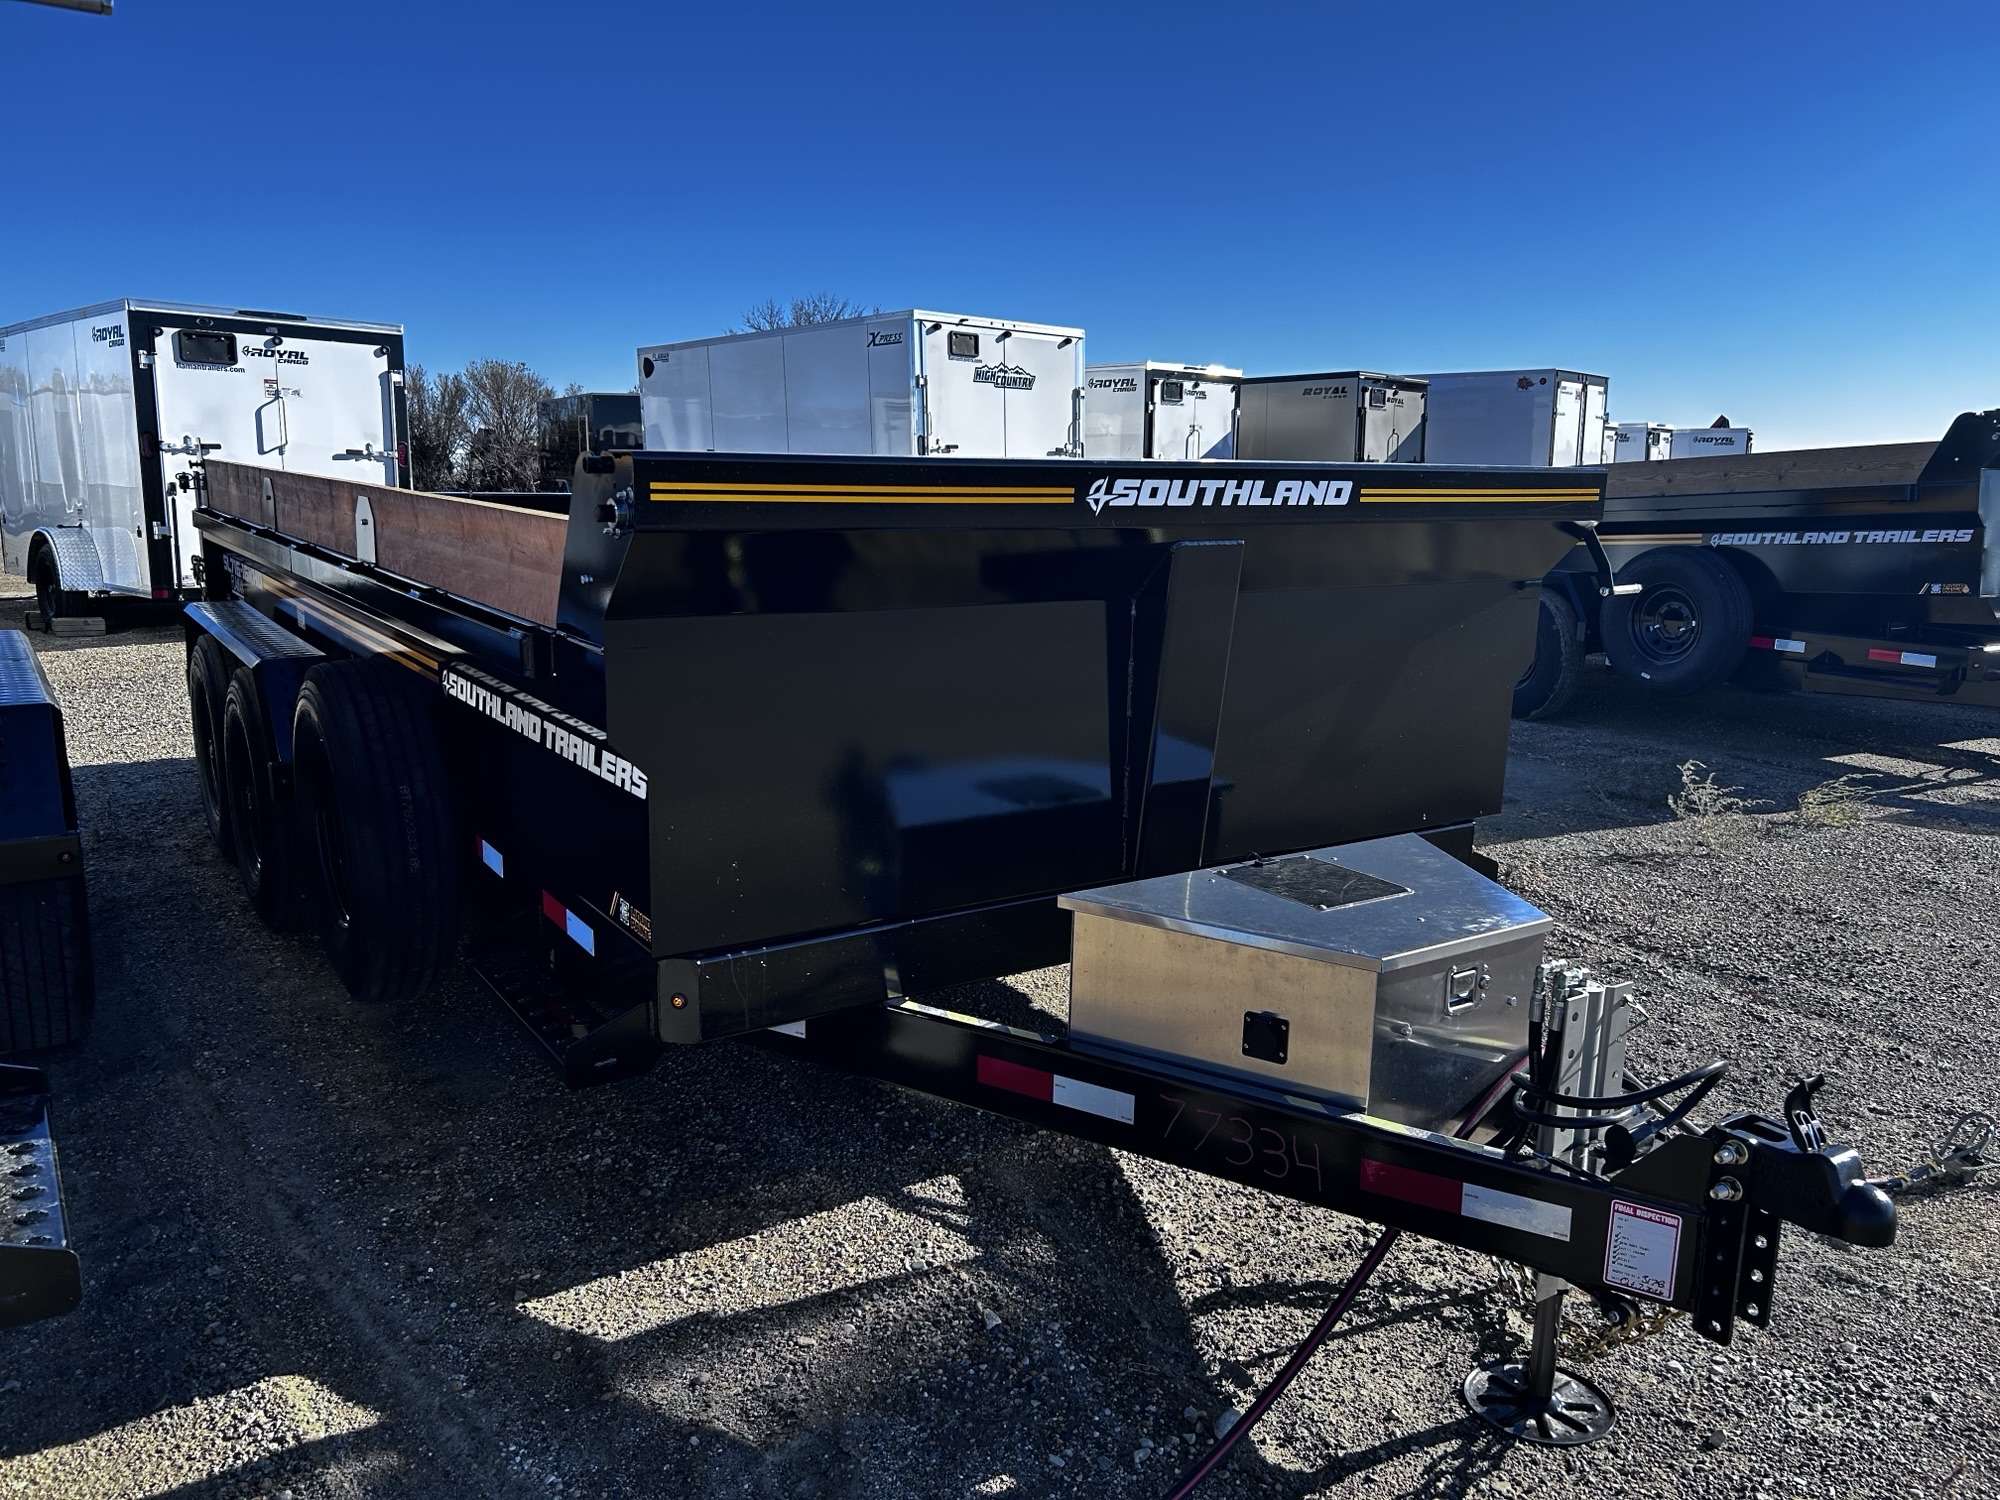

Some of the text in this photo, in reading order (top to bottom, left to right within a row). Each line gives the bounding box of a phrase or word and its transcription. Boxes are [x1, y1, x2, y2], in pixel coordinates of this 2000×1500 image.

[96, 325, 124, 342] ROYAL
[866, 331, 903, 347] XPRESS
[250, 348, 309, 360] ROYAL
[975, 370, 996, 381] HIGH
[996, 376, 1034, 388] COUNTRY
[1094, 378, 1137, 388] ROYAL
[1303, 386, 1348, 396] ROYAL
[1109, 479, 1353, 506] SOUTHLAND
[1720, 529, 1975, 545] SOUTHLAND TRAILERS
[449, 672, 649, 800] SOUTHLAND TRAILERS
[1159, 1093, 1322, 1193] 77334
[1614, 1203, 1679, 1227] FINAL INSPECTION
